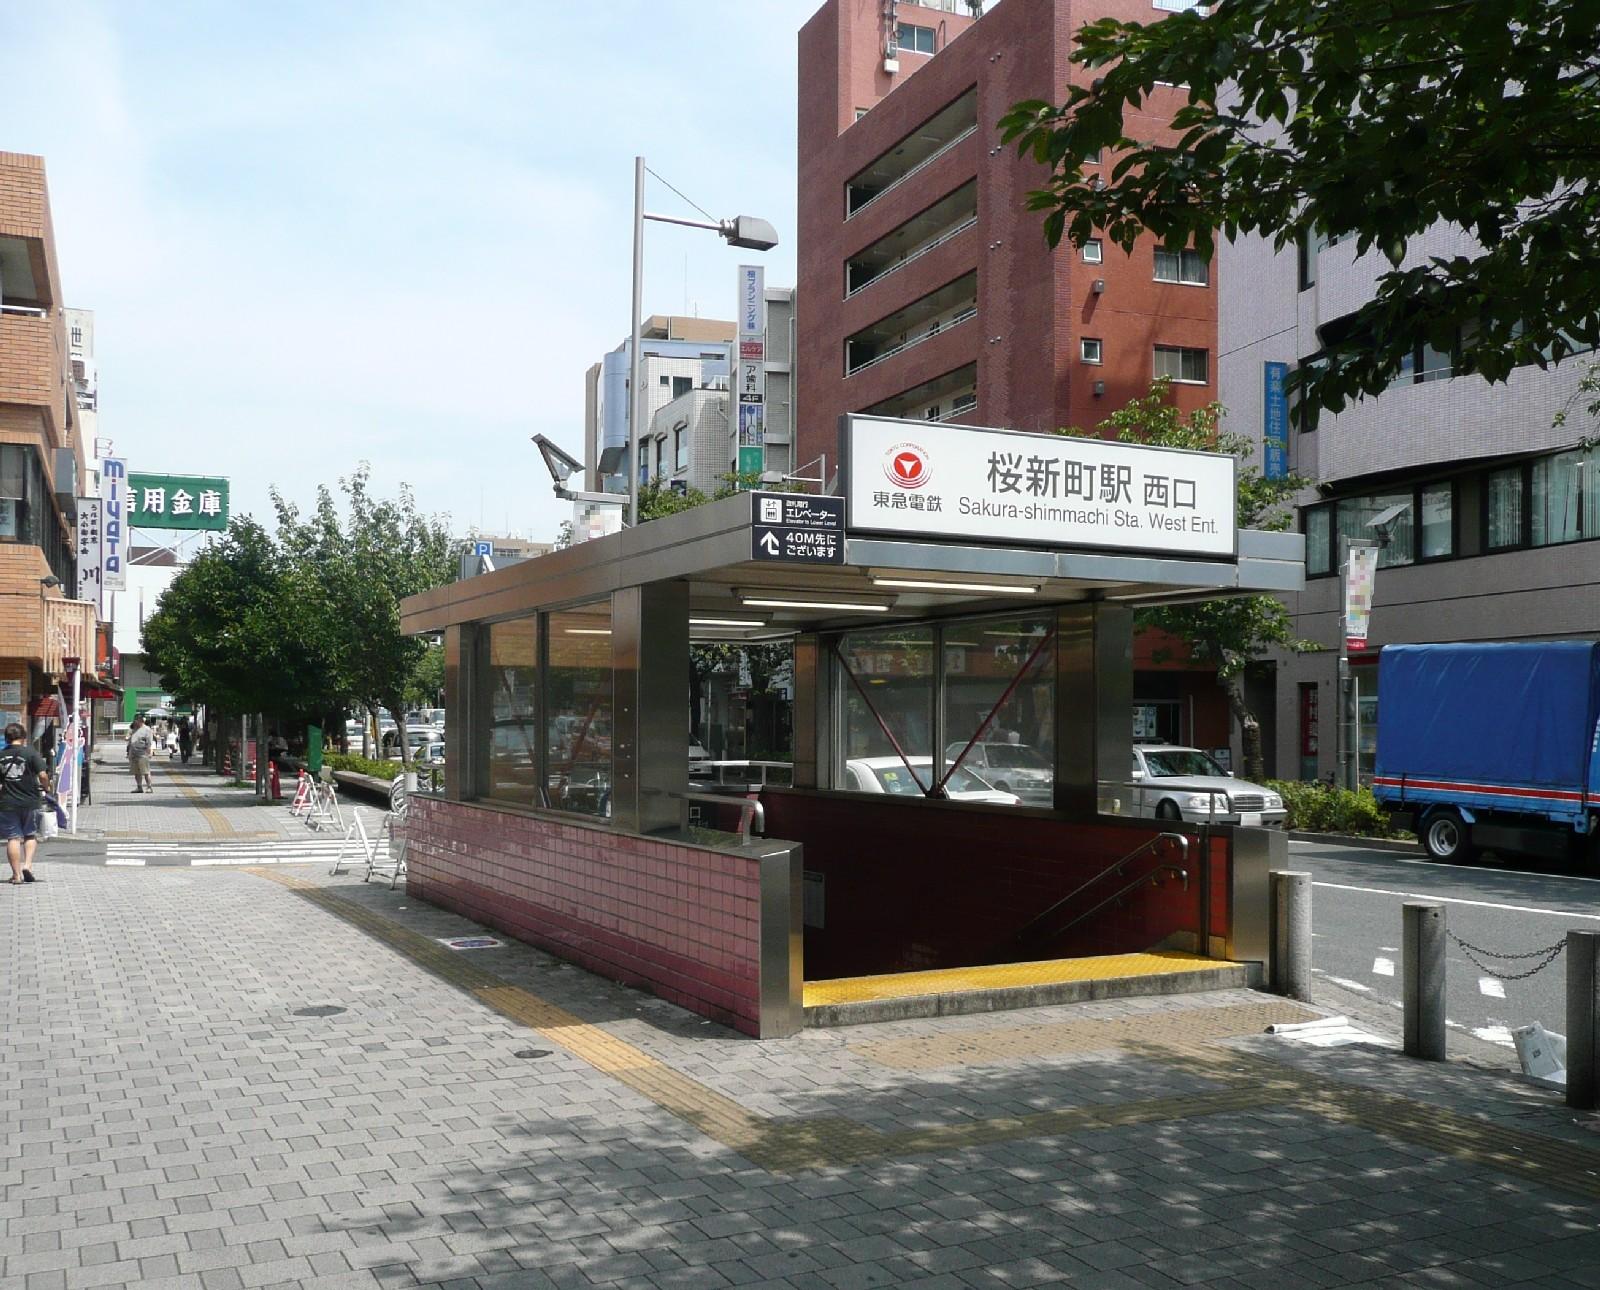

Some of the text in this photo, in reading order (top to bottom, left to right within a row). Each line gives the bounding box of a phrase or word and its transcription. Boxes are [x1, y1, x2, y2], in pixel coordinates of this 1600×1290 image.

[742, 394, 759, 402] 4F
[987, 452, 1197, 510] 桜新町駅 西口
[873, 491, 943, 513] 東急電鉄
[786, 508, 837, 520] エレベーター
[959, 497, 1219, 535] Sakura-shimmachi Sta. West Ent.
[785, 532, 837, 545] 40M先に
[786, 545, 837, 558] ございます
